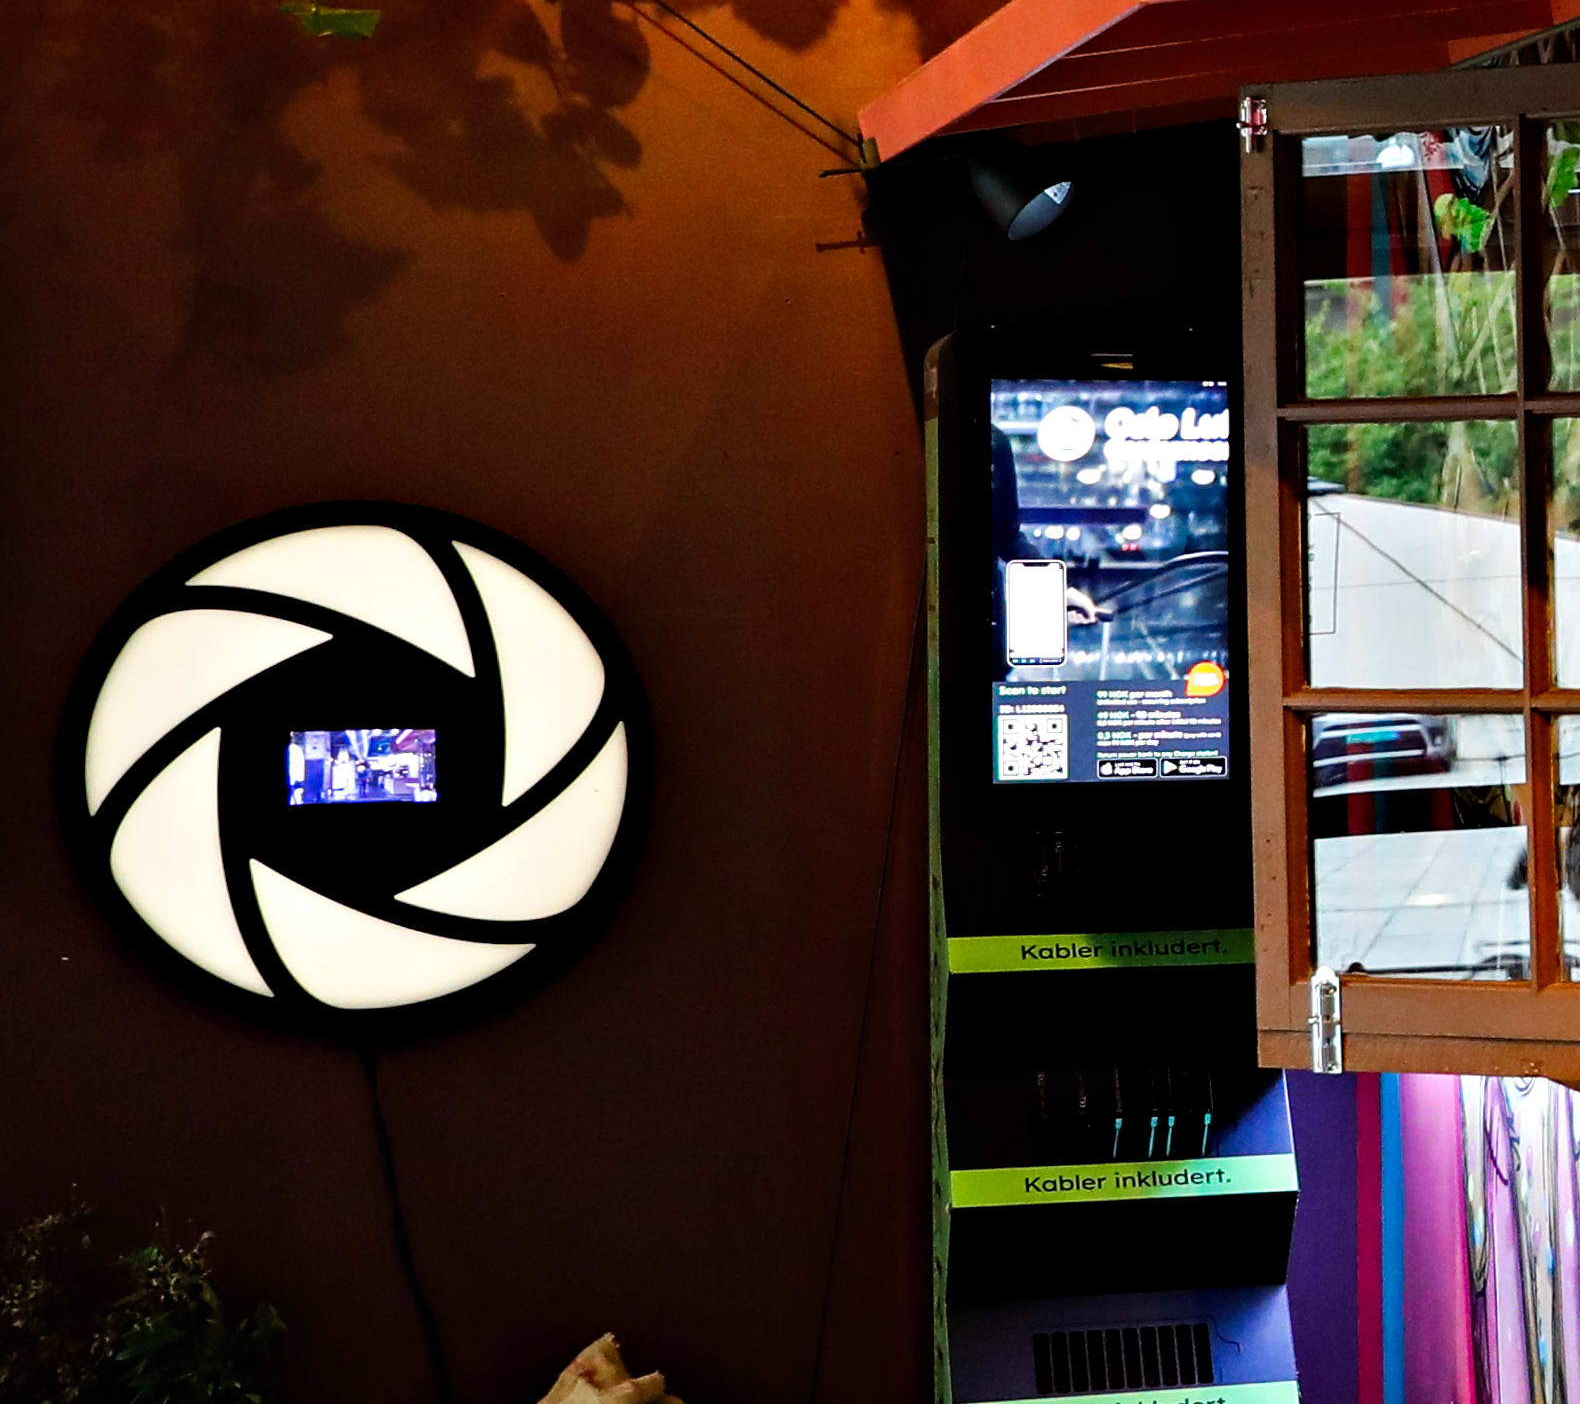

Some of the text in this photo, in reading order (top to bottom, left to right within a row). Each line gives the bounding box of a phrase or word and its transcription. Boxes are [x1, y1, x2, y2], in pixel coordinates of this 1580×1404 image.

[1040, 684, 1068, 695] start
[1020, 936, 1228, 960] Kabler inkludert.
[1023, 1166, 1231, 1193] Kabler inkludert.
